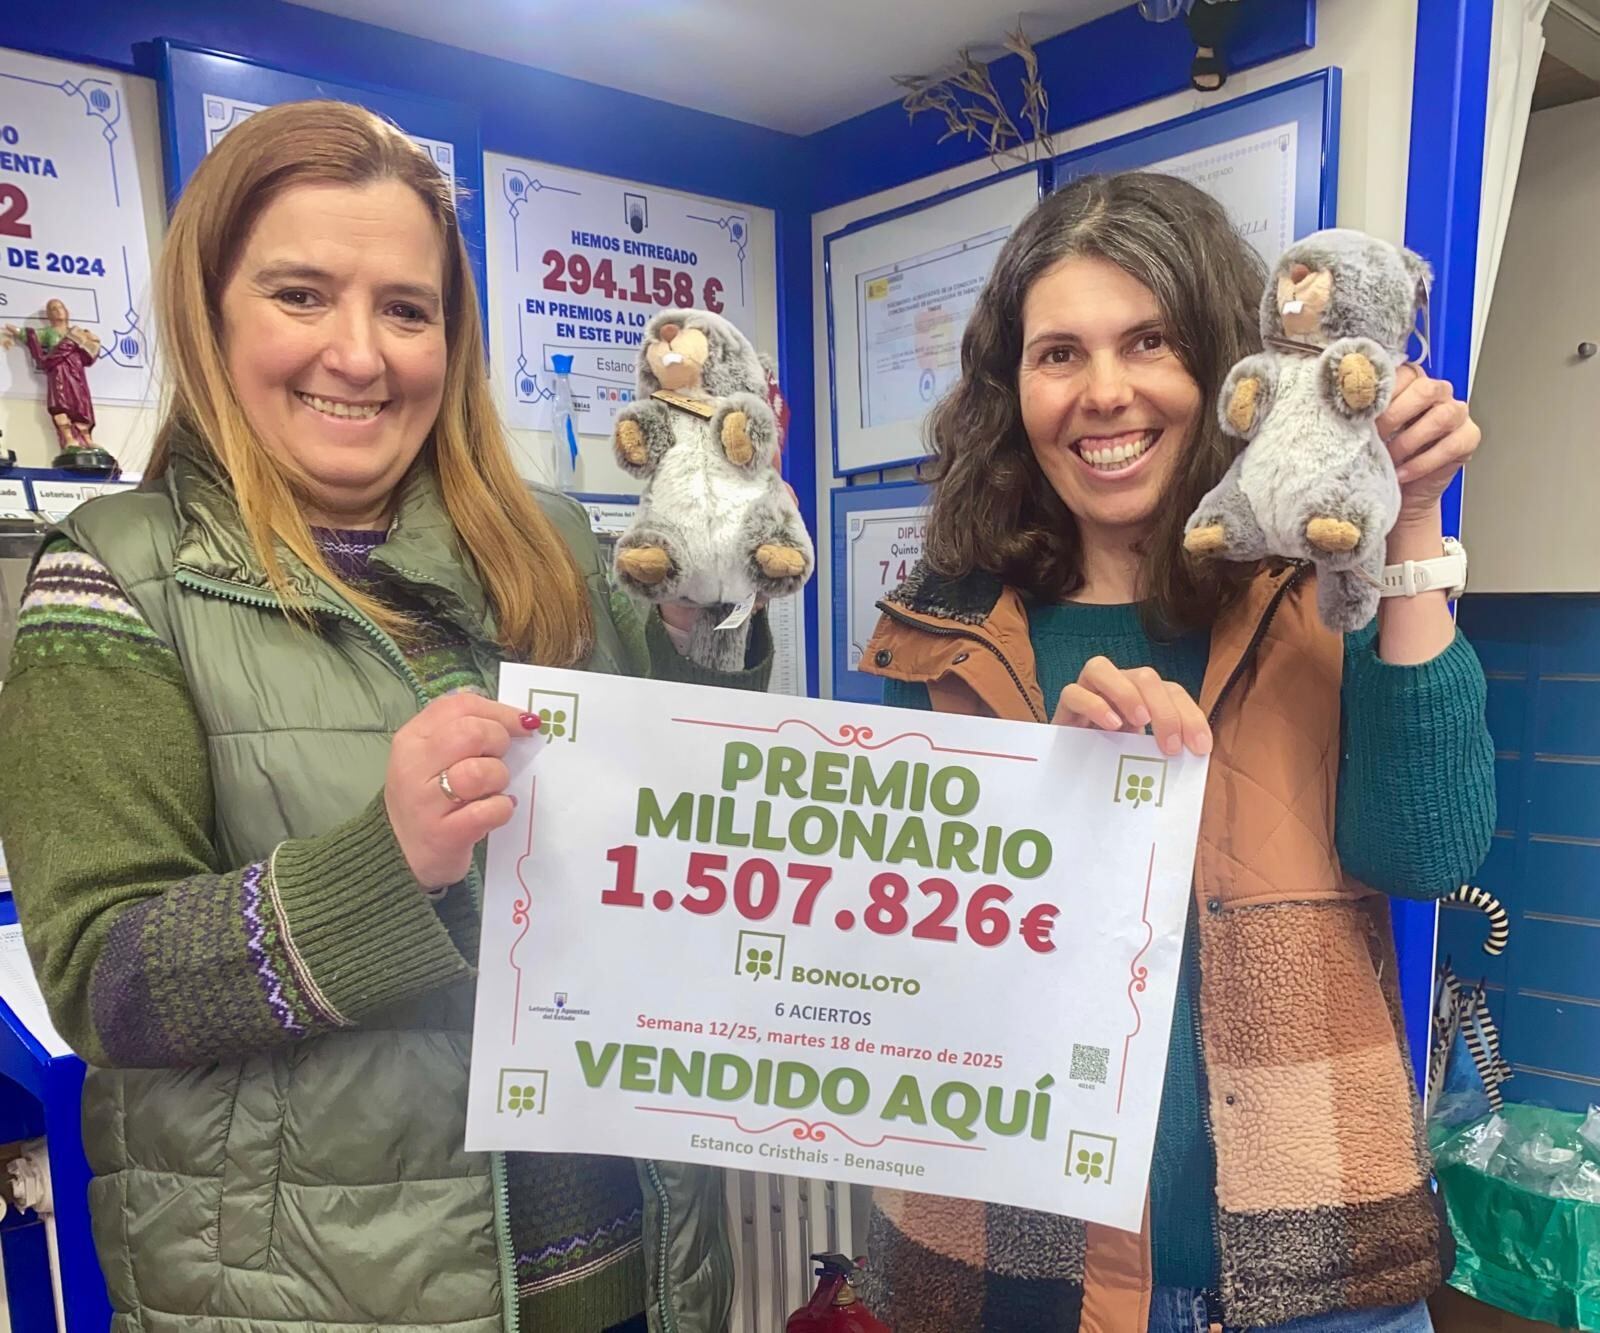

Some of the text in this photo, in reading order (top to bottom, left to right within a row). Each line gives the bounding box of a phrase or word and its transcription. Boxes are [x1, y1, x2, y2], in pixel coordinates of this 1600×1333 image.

[0, 125, 19, 145] O
[7, 247, 105, 277] DE 2024
[572, 230, 698, 266] HEMOS ENTREGADO
[542, 249, 724, 315] 294.158 €
[526, 298, 545, 315] EN
[549, 302, 613, 323] PREMIOS
[616, 310, 625, 325] A
[557, 323, 575, 339] EN
[578, 325, 612, 343] ESTE
[890, 543, 919, 557] Quinto
[721, 741, 980, 816] PREMIO
[635, 787, 1053, 879] MILLONARIO
[791, 966, 921, 996] BONOLOTO
[774, 1002, 872, 1026] 6 ACIERTOS
[636, 1014, 1003, 1069] Semana 12/25, martes 18 de marzo de 2025
[575, 1040, 1056, 1142] VENDIDO AQUÍ
[690, 1134, 754, 1155] Estanco
[758, 1143, 829, 1165] Cristhais
[844, 1153, 926, 1177] Benasque
